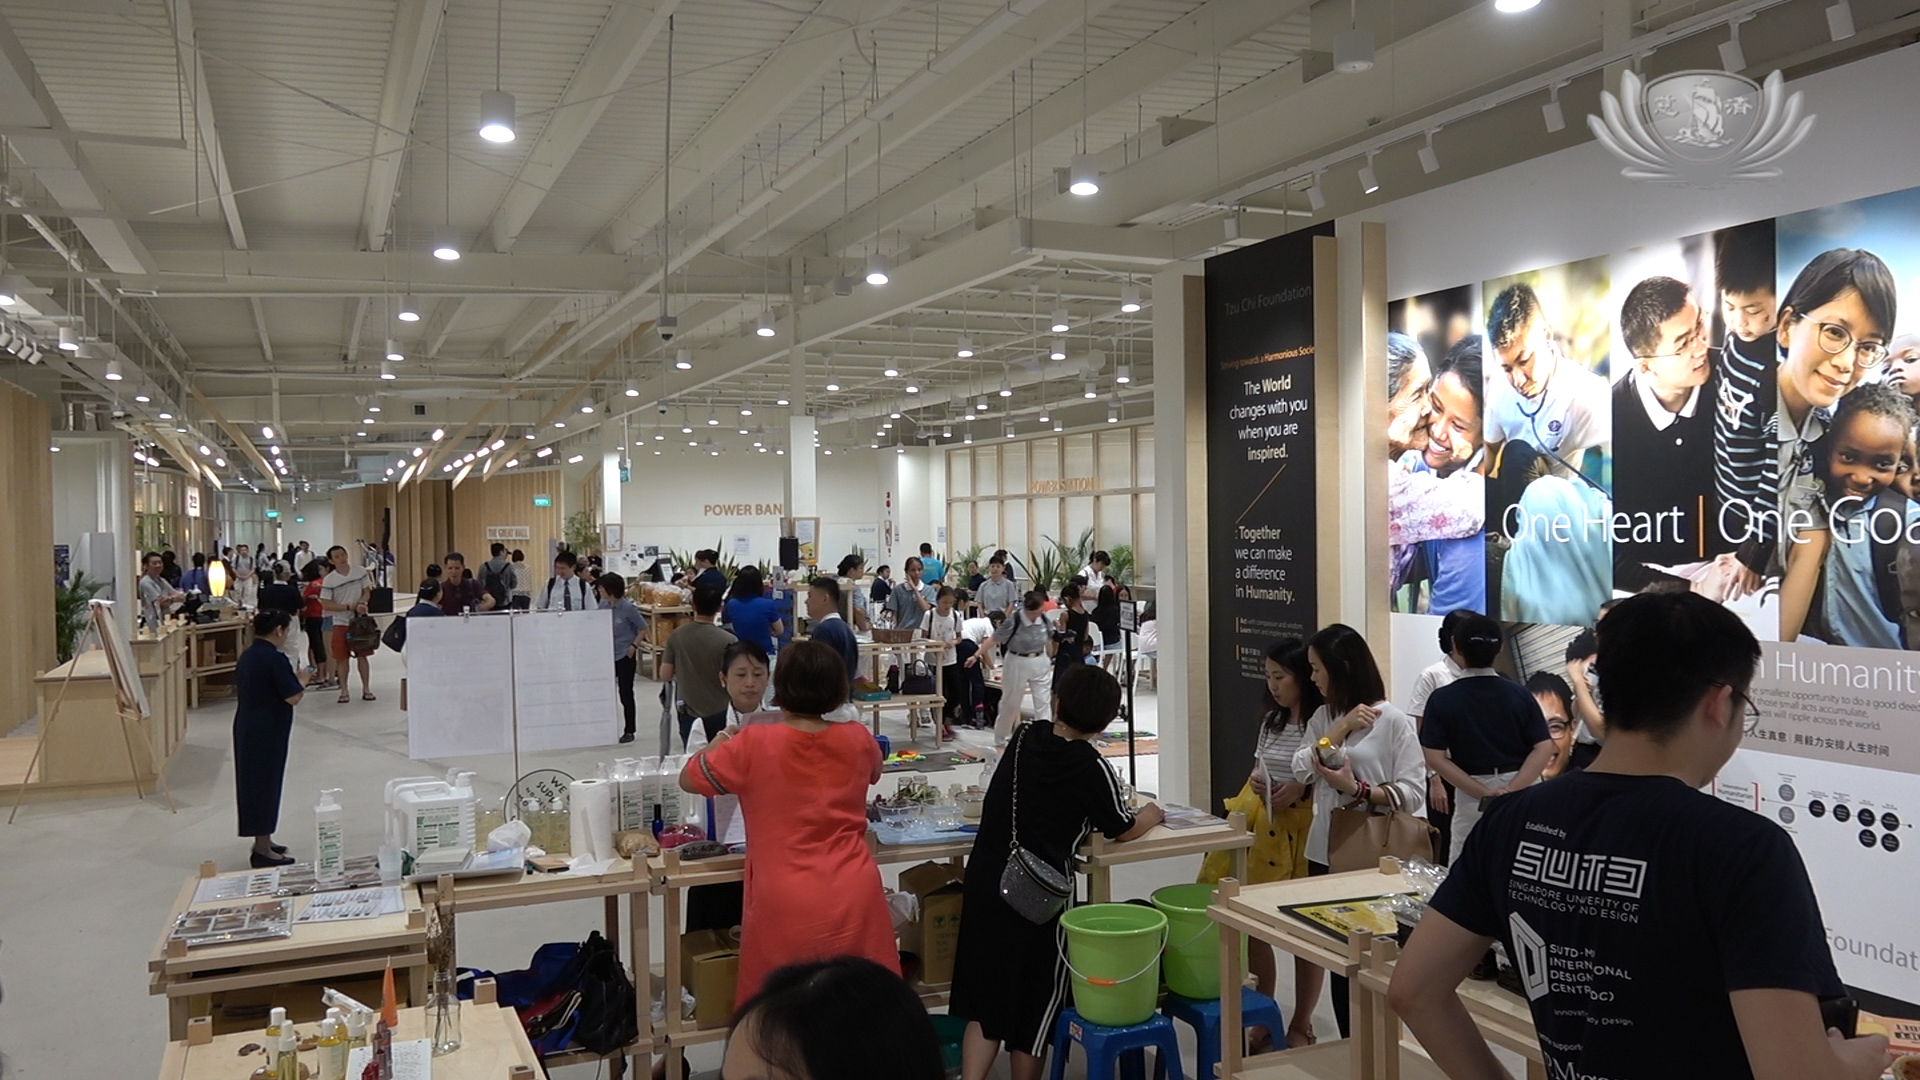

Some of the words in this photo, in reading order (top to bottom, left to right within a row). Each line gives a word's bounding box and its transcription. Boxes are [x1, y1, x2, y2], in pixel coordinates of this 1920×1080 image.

[1225, 302, 1240, 316] Tzu
[1241, 296, 1257, 312] Chi
[1257, 285, 1312, 308] Foundation
[1264, 349, 1298, 362] Harmonious
[1244, 381, 1261, 396] The
[1262, 374, 1291, 393] World
[1229, 402, 1266, 422] changes
[1267, 397, 1288, 414] with
[1289, 398, 1308, 416] you
[1238, 425, 1264, 440] when
[1264, 425, 1283, 441] you
[1283, 422, 1299, 436] are
[1247, 444, 1289, 463] inspired.
[704, 504, 753, 516] POWER
[1502, 503, 1571, 544] One
[1582, 502, 1685, 544] Heart
[1718, 498, 1814, 545] One
[1239, 525, 1281, 542] Together
[1235, 548, 1249, 560] we
[1250, 548, 1266, 560] can
[1267, 545, 1293, 561] make
[1235, 568, 1241, 579] a
[1242, 564, 1286, 581] difference
[1235, 585, 1245, 598] in
[1245, 585, 1296, 605] Humanity.
[1775, 651, 1920, 694] Humanit
[1757, 697, 1779, 708] those
[1779, 699, 1799, 709] small
[1801, 703, 1818, 713] acts
[1760, 688, 1790, 698] smallest
[1791, 691, 1839, 705] opportunity
[1841, 695, 1851, 704] to
[1852, 695, 1865, 706] do
[1873, 698, 1897, 710] good
[1773, 710, 1787, 718] will
[1788, 712, 1811, 723] ripple
[1812, 716, 1838, 726] across
[1839, 717, 1854, 727] the
[550, 776, 567, 794] WE
[1525, 821, 1557, 838] Established
[1558, 830, 1567, 840] by
[1508, 879, 1562, 901] SINGAPORE
[1622, 902, 1640, 912] OF
[1508, 890, 1576, 913] TECHNOLOGY
